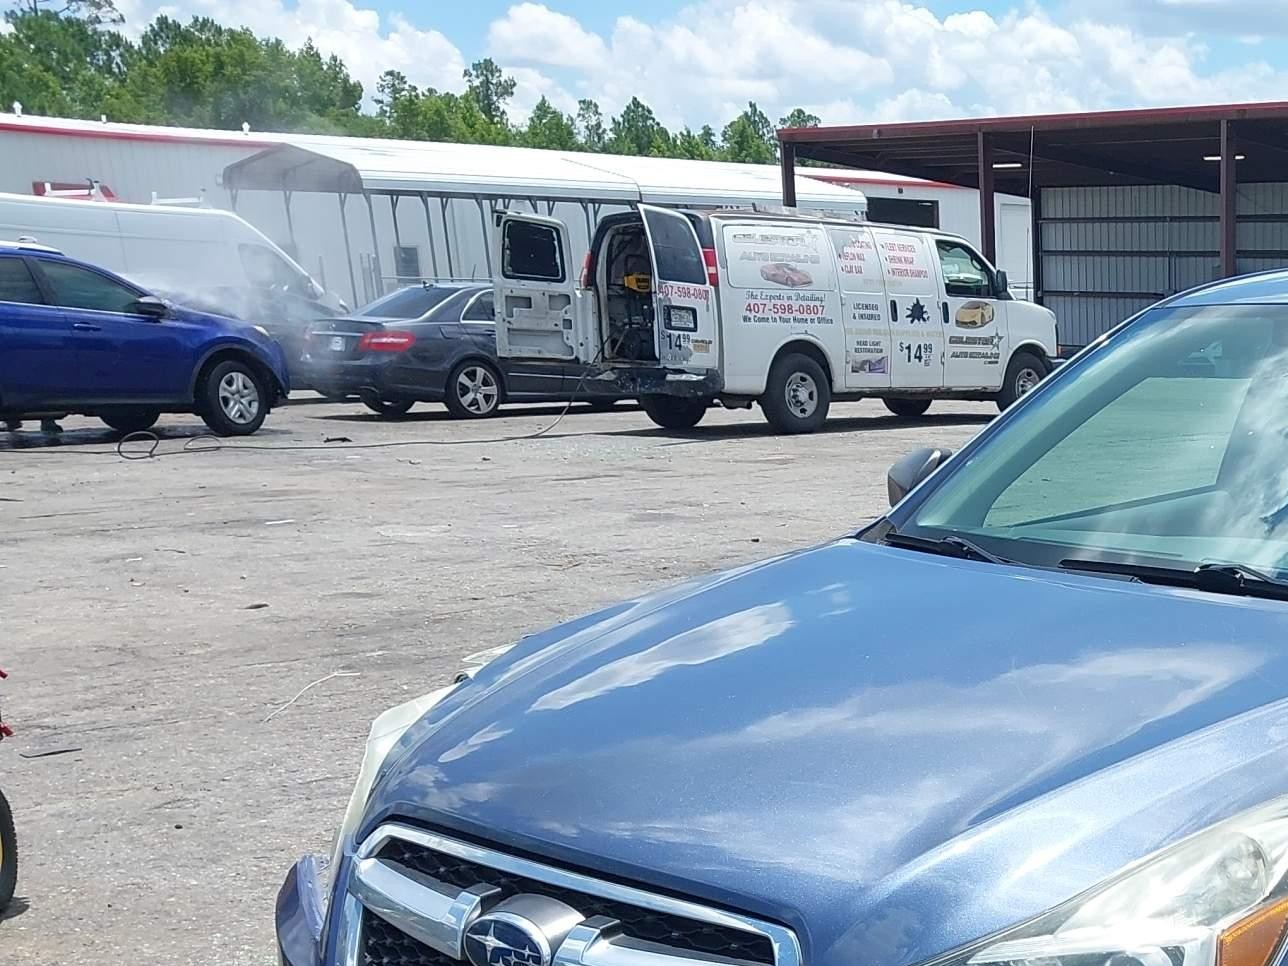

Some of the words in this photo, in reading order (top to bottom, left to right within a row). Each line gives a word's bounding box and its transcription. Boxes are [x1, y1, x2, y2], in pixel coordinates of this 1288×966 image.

[745, 303, 825, 315] 407-598-0807
[742, 315, 752, 323] We
[753, 315, 770, 323] Come
[779, 316, 792, 324] Your
[793, 316, 808, 324] Home
